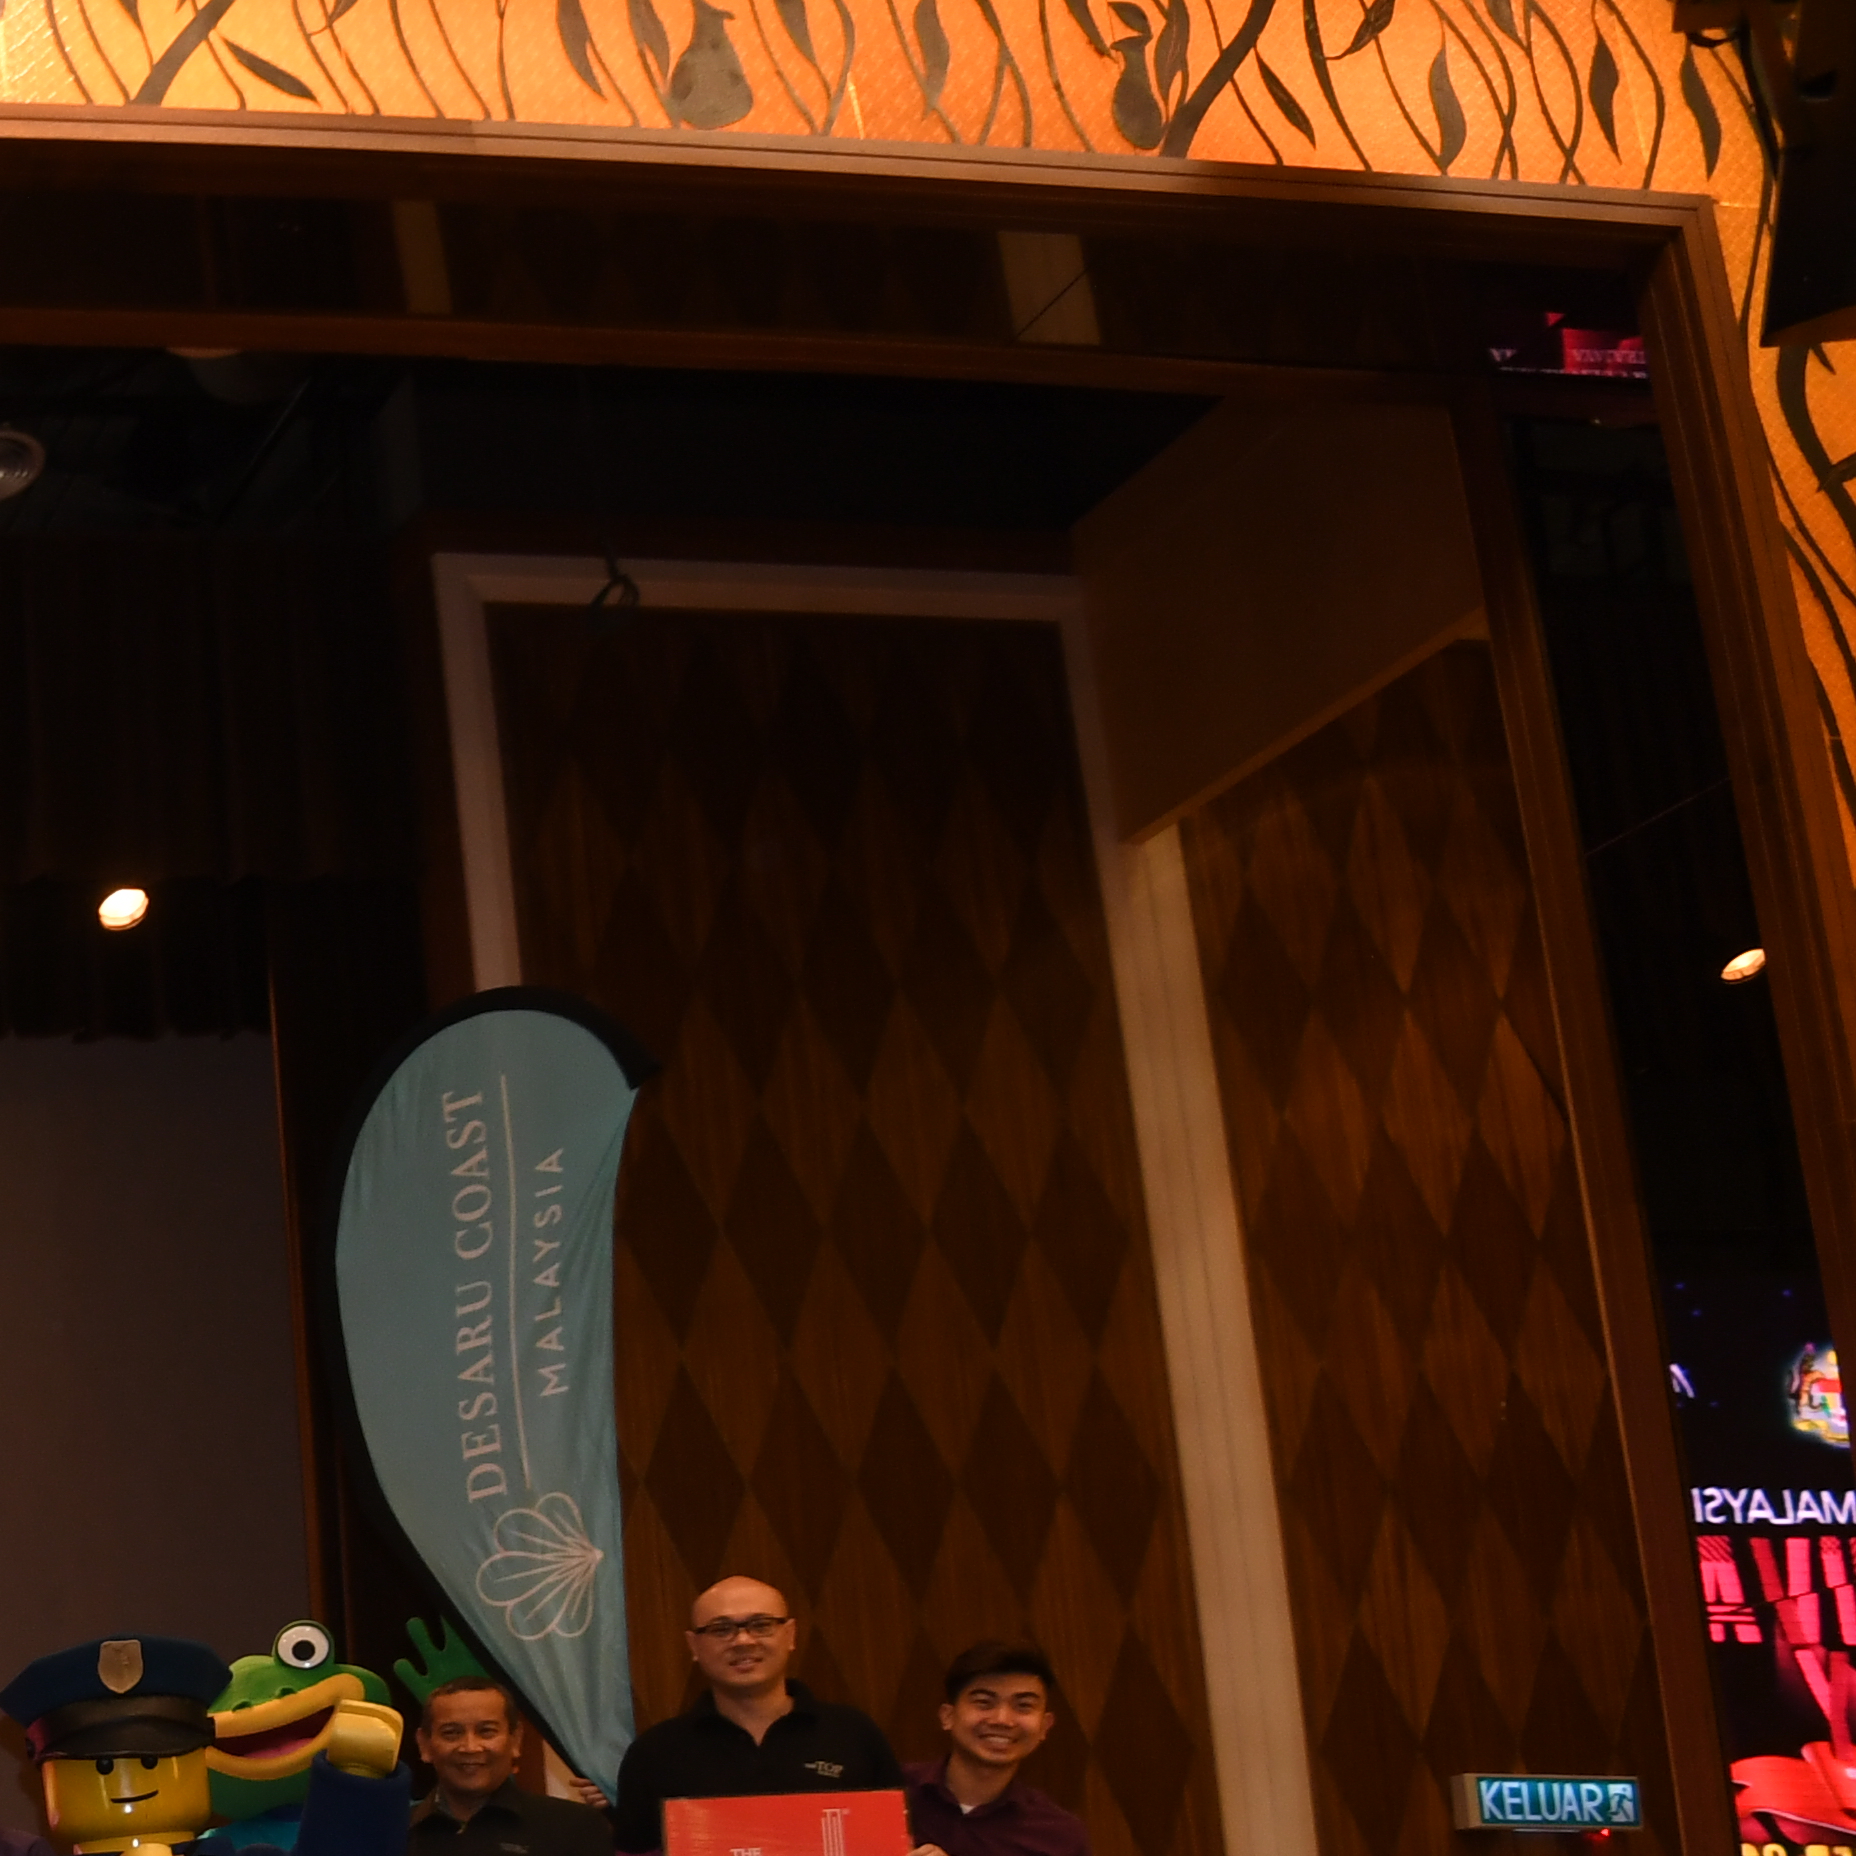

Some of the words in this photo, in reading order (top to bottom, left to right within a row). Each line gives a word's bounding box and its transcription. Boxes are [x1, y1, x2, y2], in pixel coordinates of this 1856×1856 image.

[441, 1091, 493, 1260] COAST
[535, 1148, 569, 1397] MALAYSIA
[454, 1281, 507, 1503] DESARU
[1479, 1779, 1605, 1823] KELUAR
